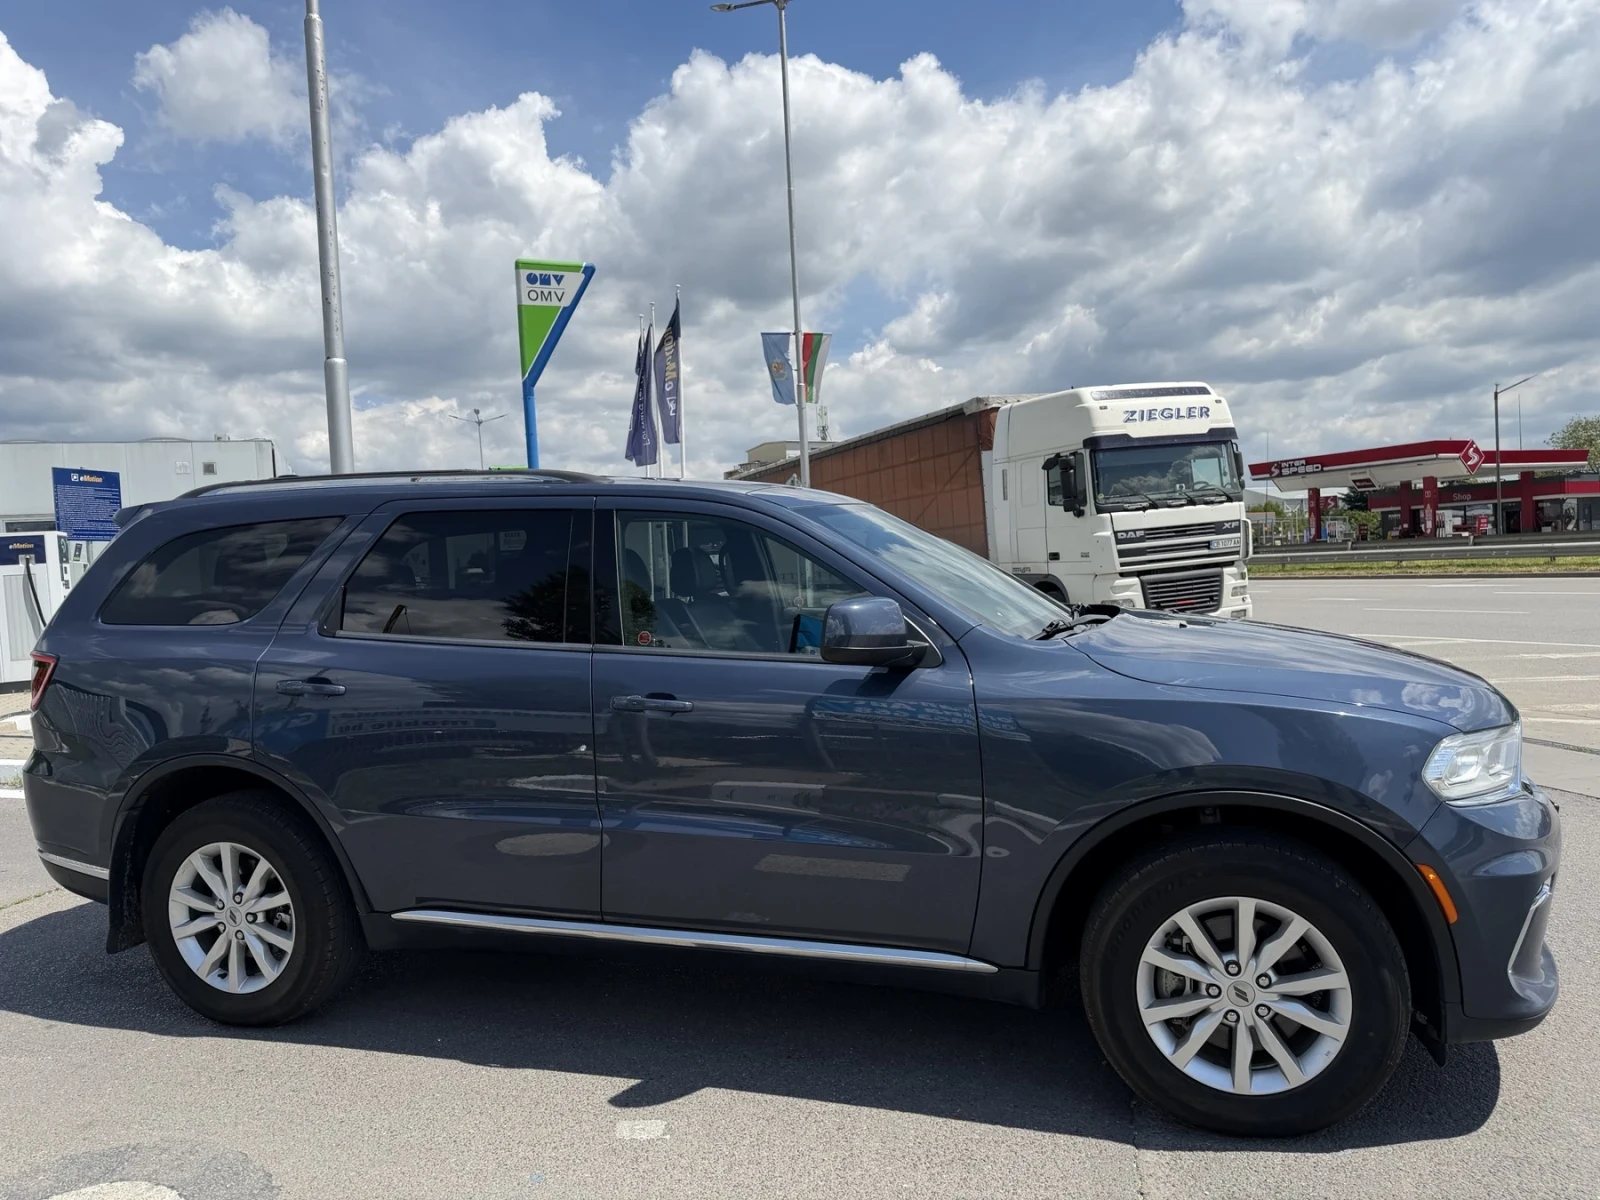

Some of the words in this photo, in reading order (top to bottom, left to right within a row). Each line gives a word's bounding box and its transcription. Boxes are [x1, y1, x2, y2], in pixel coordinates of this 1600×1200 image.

[527, 289, 565, 303] OMV
[1123, 406, 1211, 423] ZIEGLER
[1281, 459, 1306, 467] INTER
[1281, 463, 1322, 476] SPEED
[79, 474, 103, 483] eMotion
[1452, 492, 1472, 501] Shop
[1222, 521, 1239, 530] XF
[1117, 530, 1145, 540] DAF
